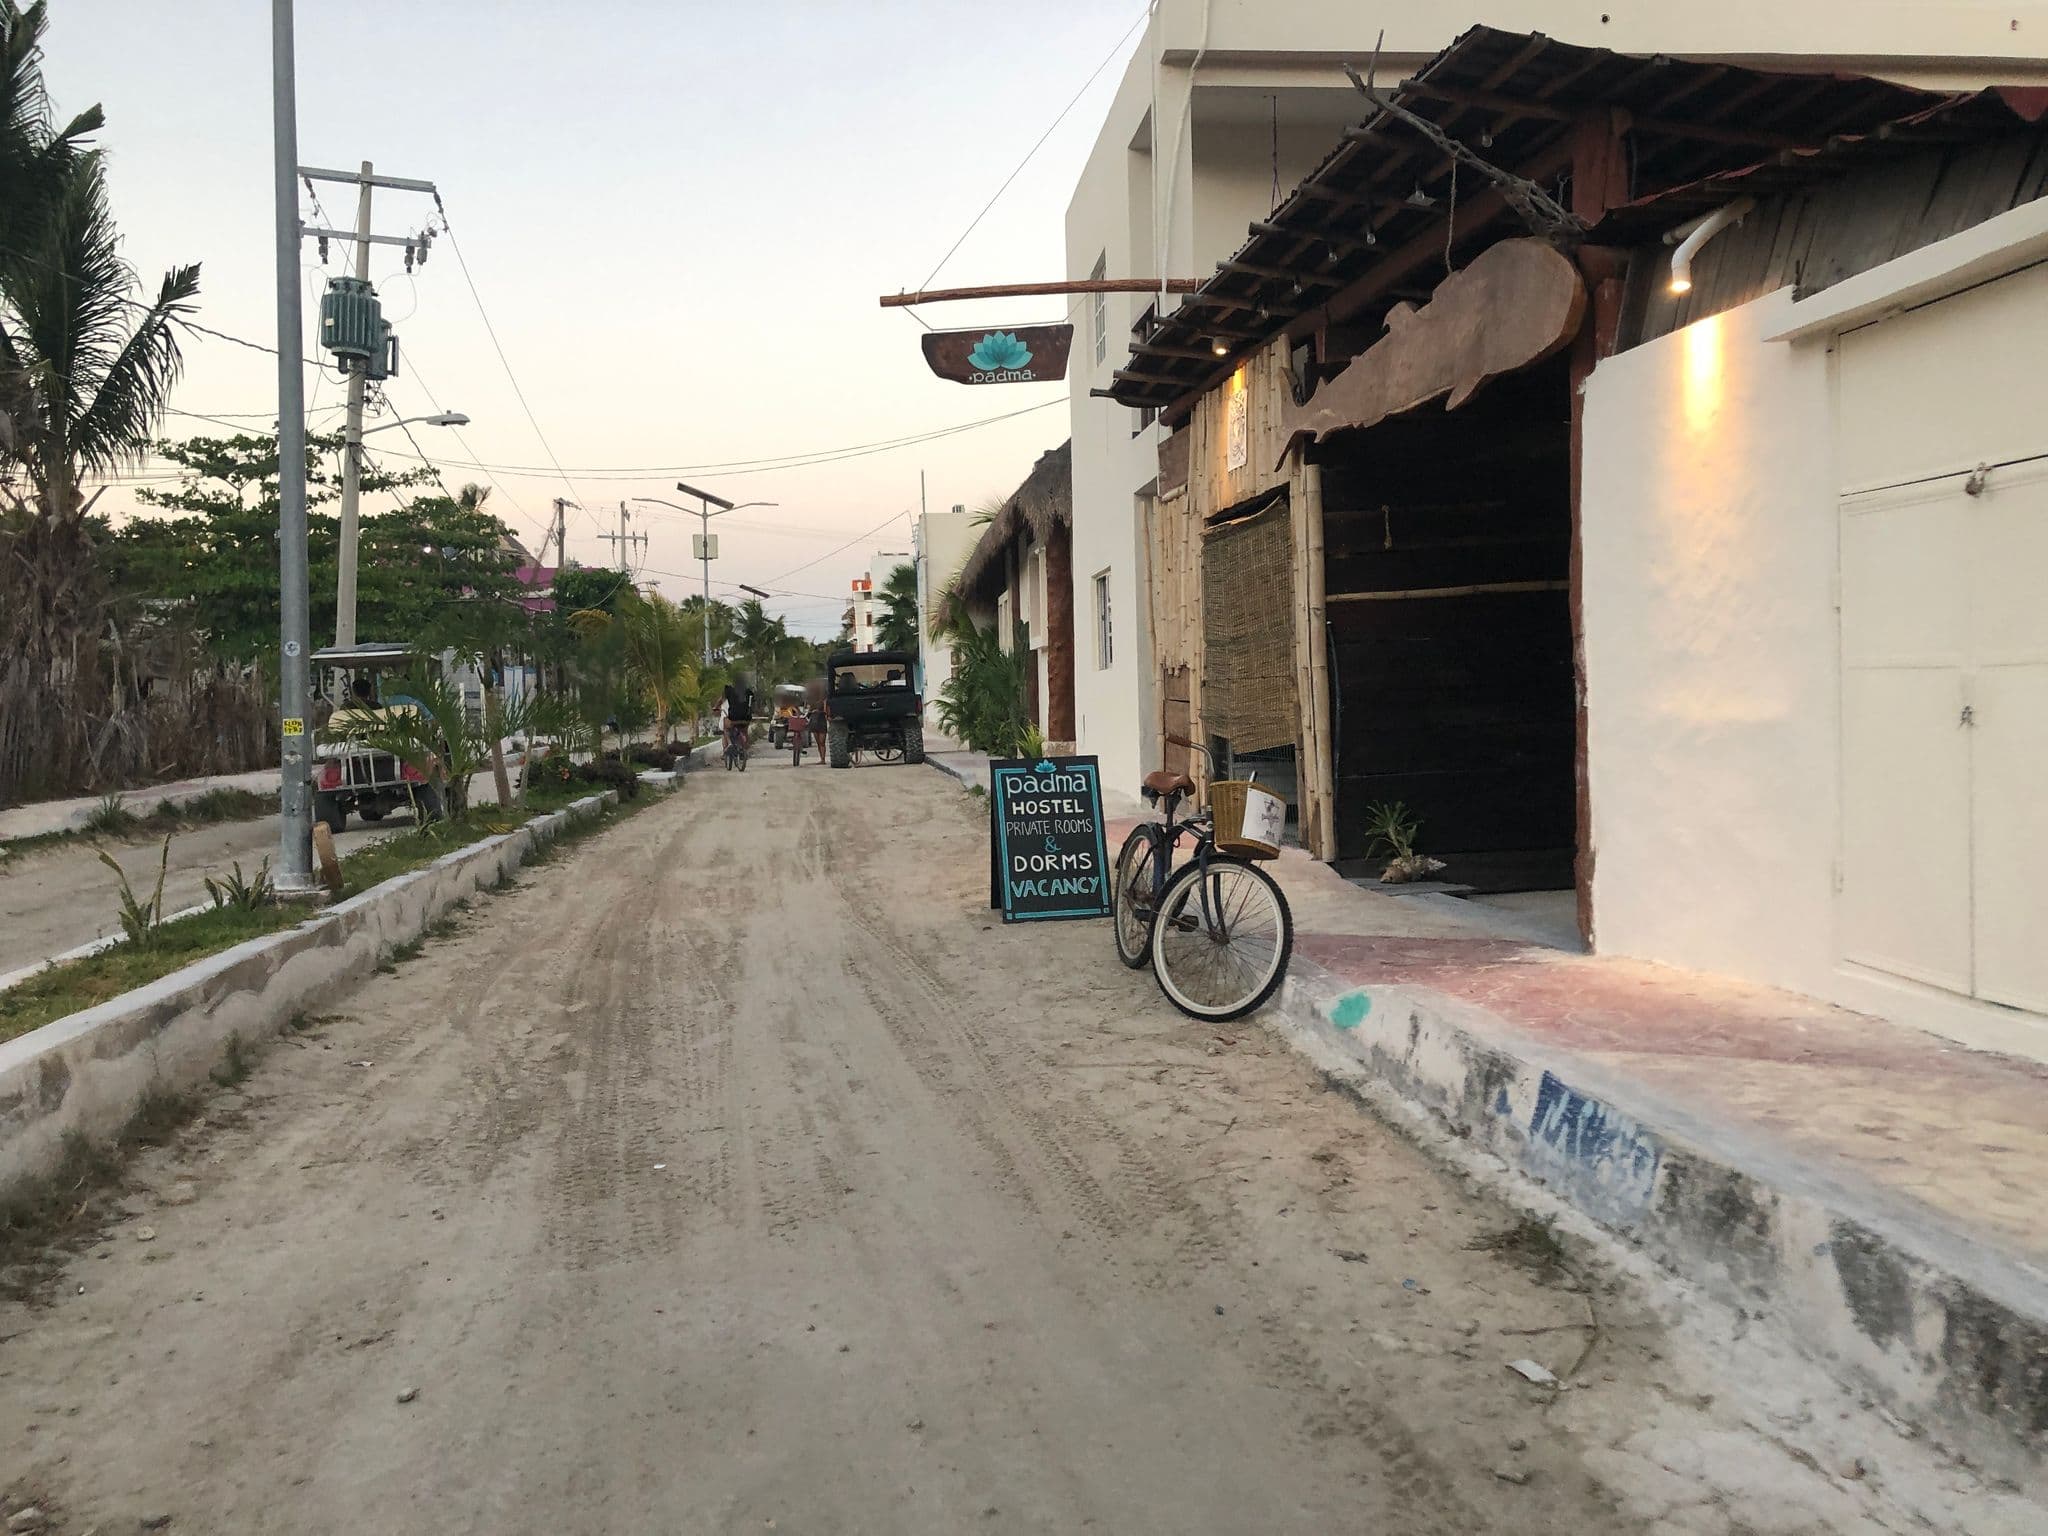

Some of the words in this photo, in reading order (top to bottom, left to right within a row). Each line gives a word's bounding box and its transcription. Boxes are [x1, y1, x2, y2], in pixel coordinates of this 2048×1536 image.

[1005, 773, 1088, 799] padma
[1012, 799, 1084, 815] HOSTEL
[1006, 820, 1051, 836] PRIVATE
[1055, 818, 1093, 834] ROOMS
[1045, 835, 1062, 853] &
[1014, 852, 1092, 872] DORMS
[1011, 876, 1100, 898] VACANCY
